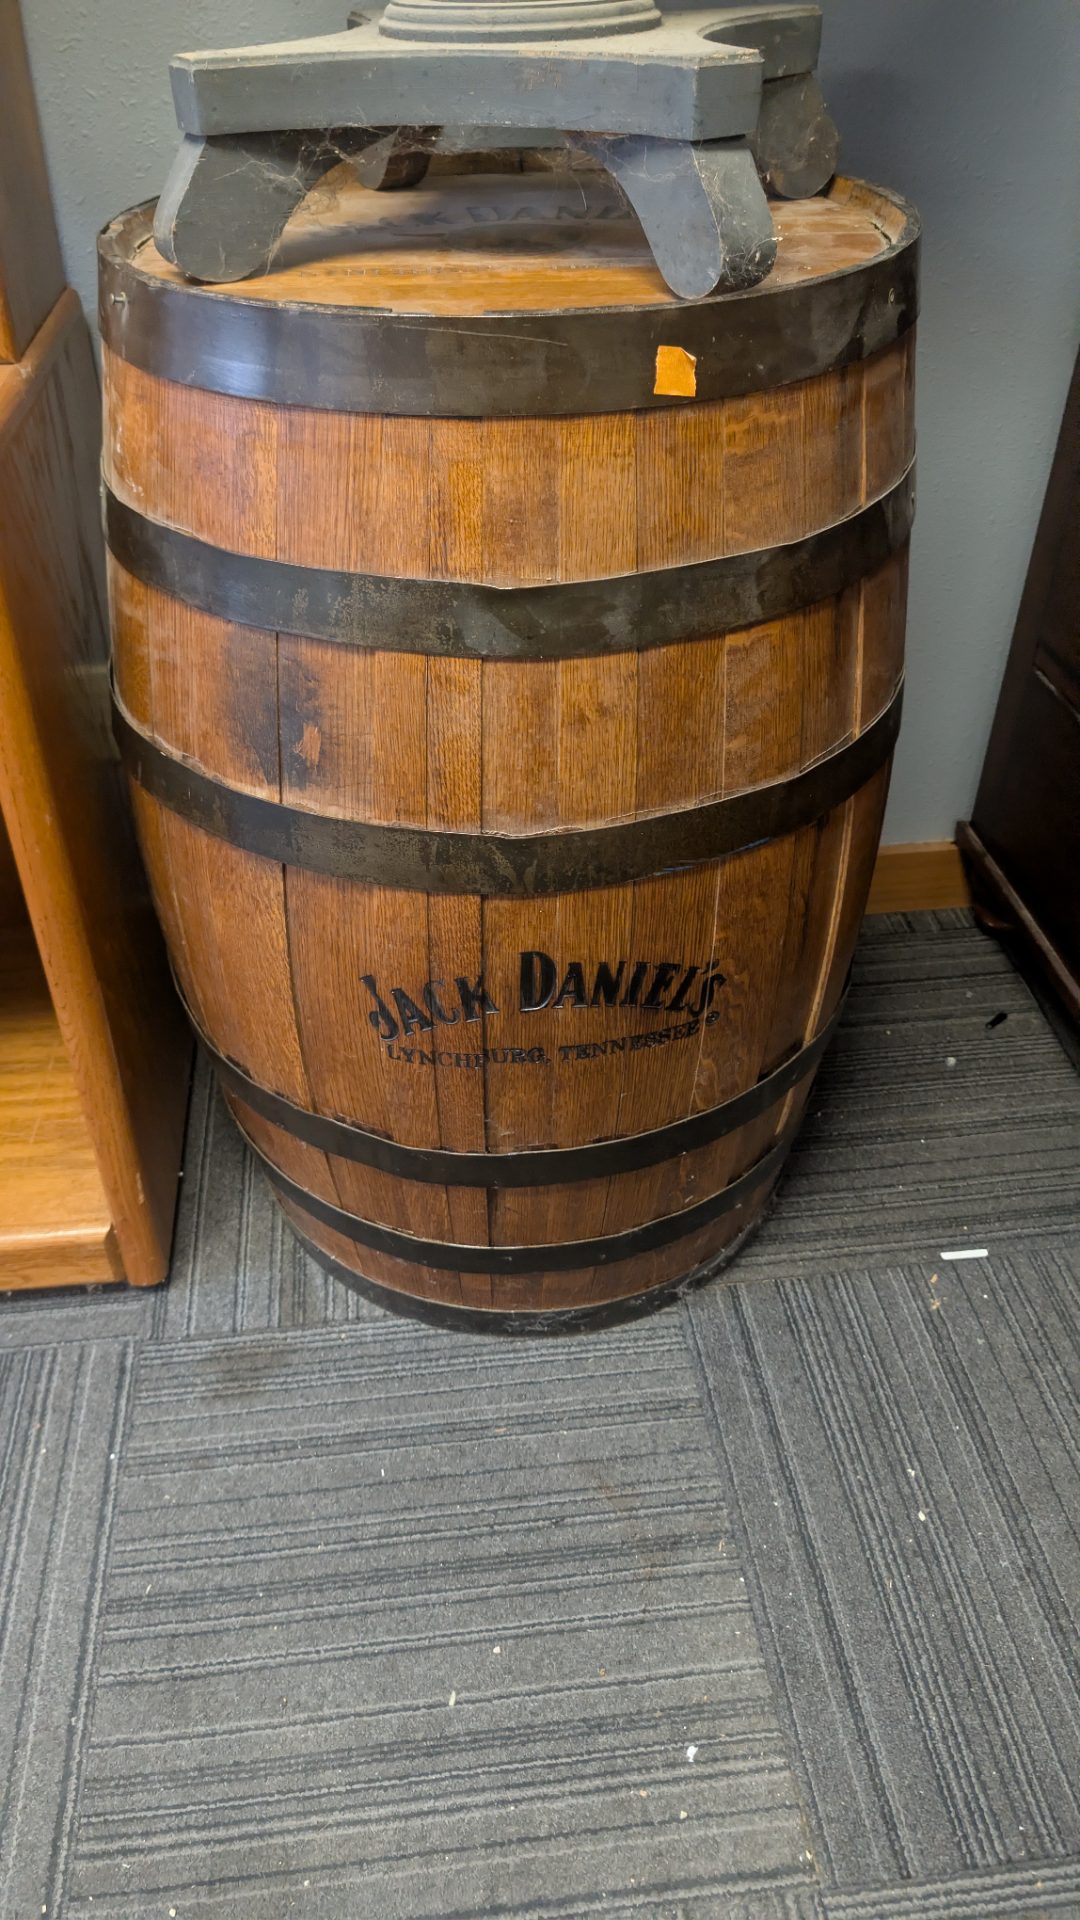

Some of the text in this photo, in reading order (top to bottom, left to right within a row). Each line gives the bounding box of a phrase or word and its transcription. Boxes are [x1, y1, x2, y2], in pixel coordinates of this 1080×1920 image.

[360, 950, 727, 1042] JACK DANIEL'S
[386, 1018, 701, 1069] LYNCHBURG, TENNESSEE
